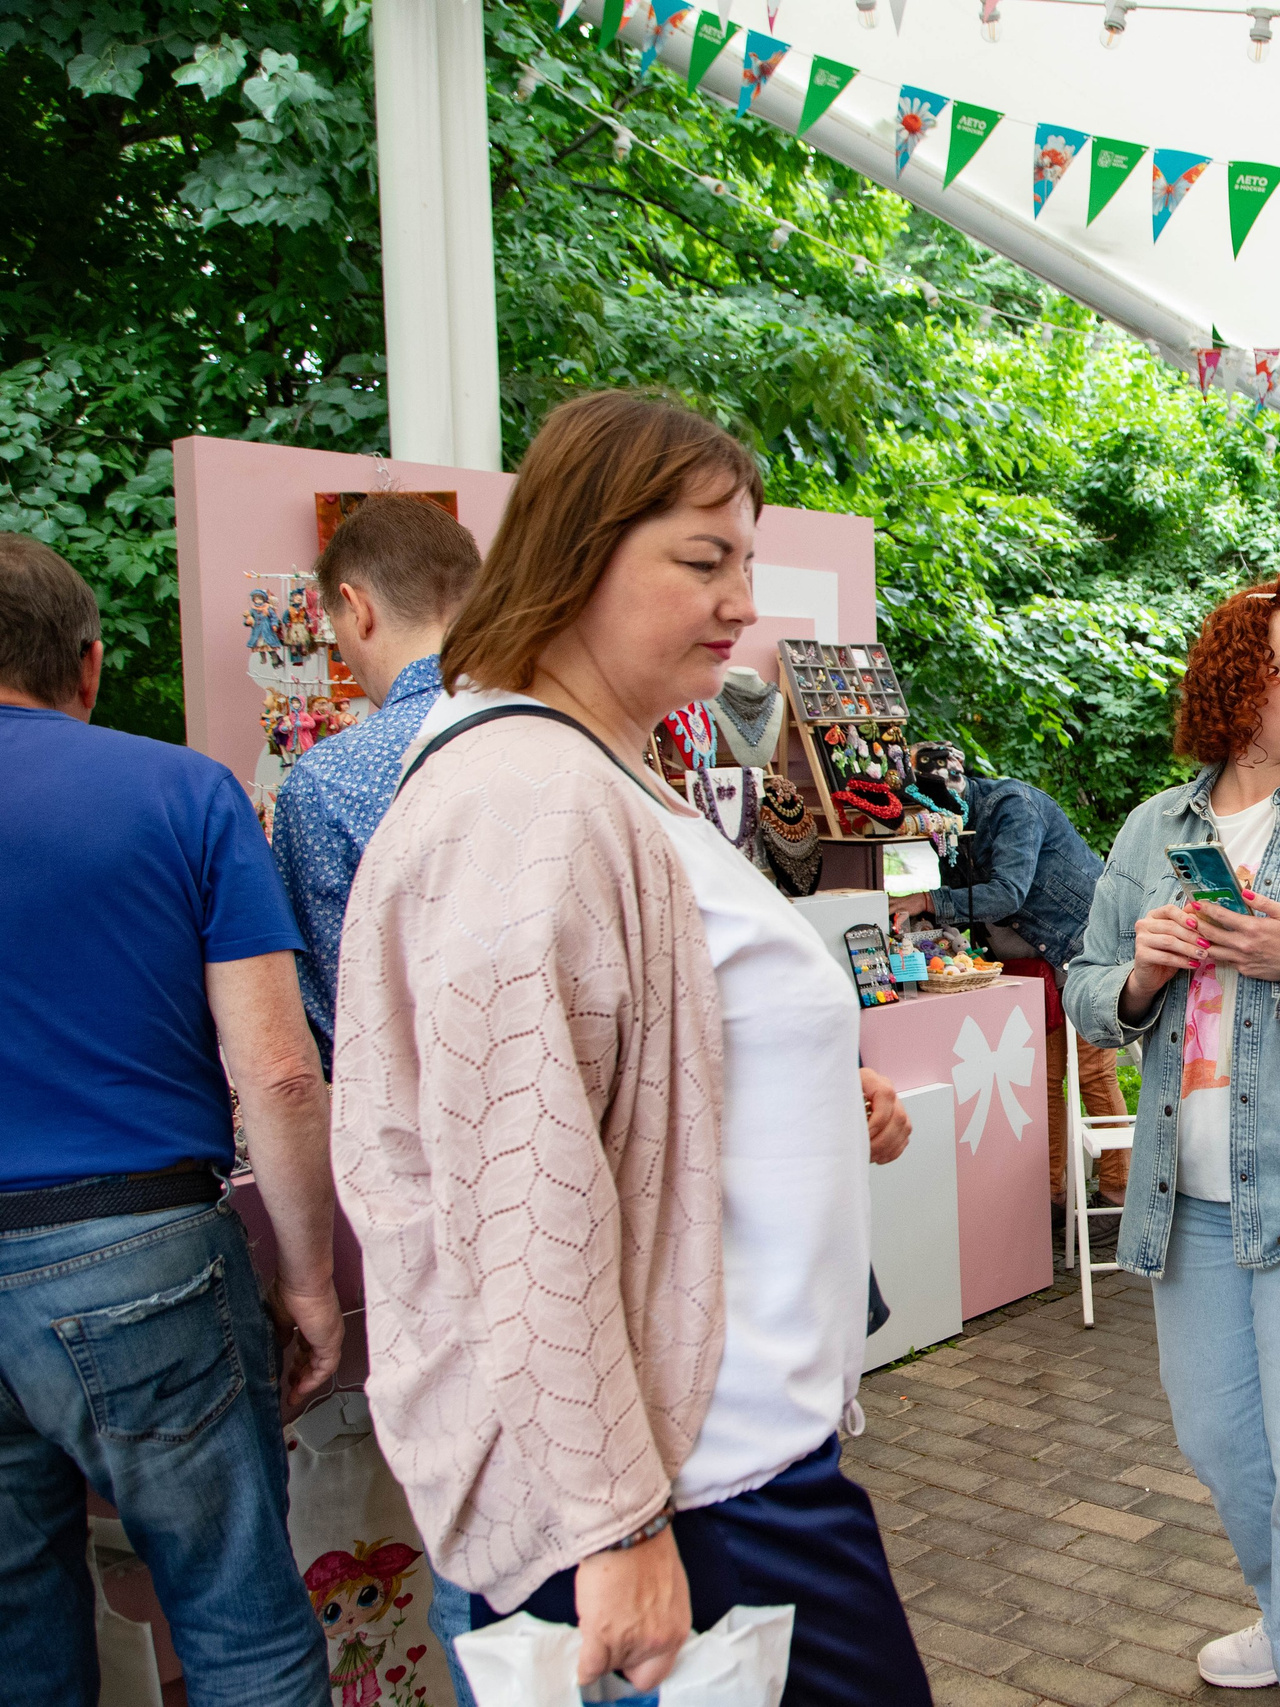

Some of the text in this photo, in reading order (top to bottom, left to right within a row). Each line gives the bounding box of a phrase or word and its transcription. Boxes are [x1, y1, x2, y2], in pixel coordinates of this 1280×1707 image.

[958, 115, 987, 130] ЛЕТО
[1236, 174, 1268, 187] ЛЕТО
[1240, 184, 1266, 193] МОСКВЕ
